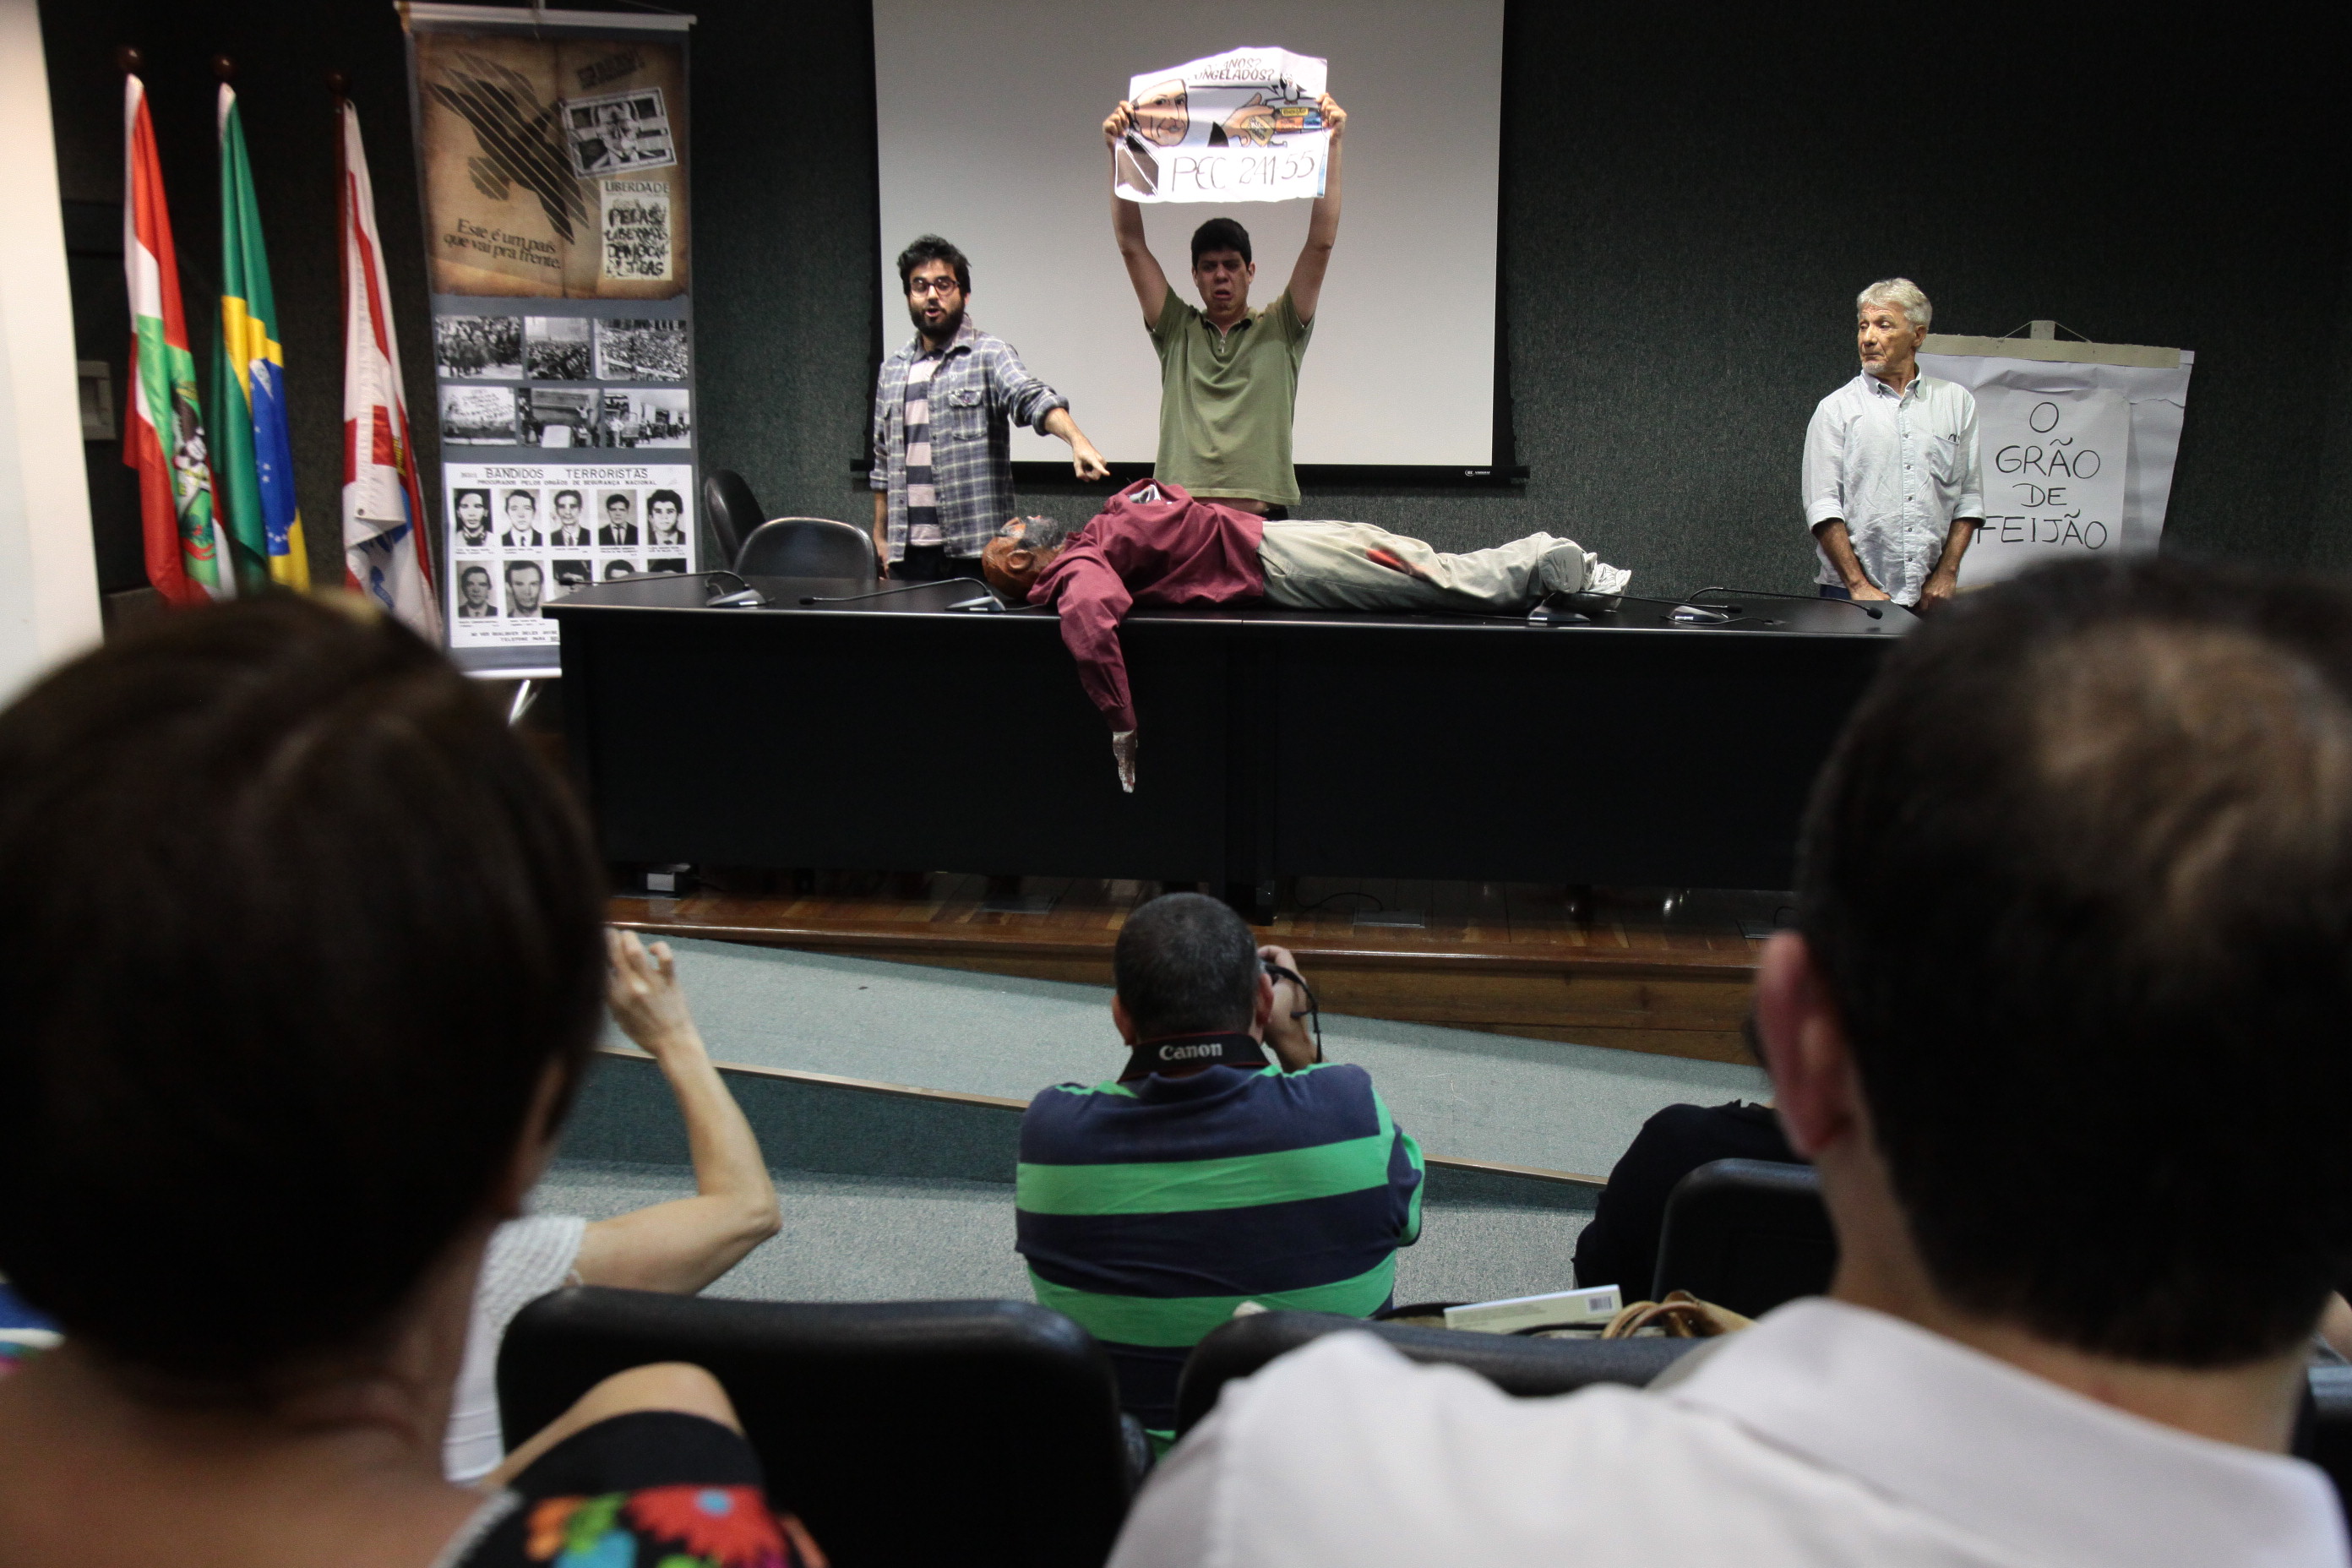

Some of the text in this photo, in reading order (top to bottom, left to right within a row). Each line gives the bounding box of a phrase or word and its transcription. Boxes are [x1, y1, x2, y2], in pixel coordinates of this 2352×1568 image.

[605, 180, 670, 194] LIBERDADE
[1172, 156, 1227, 193] PEC
[444, 233, 470, 248] que
[471, 239, 492, 253] vai
[493, 244, 517, 259] pra
[457, 218, 488, 238] Este
[491, 228, 501, 242] é
[502, 232, 526, 249] um
[2029, 401, 2059, 433] O
[1995, 437, 2101, 479] GRÃO
[485, 467, 544, 479] BANDIDOS
[564, 468, 649, 479] TERRORISTAS
[2012, 482, 2067, 508] DE
[1977, 508, 2108, 550] FEIJÃO
[1158, 1043, 1223, 1061] Canon
